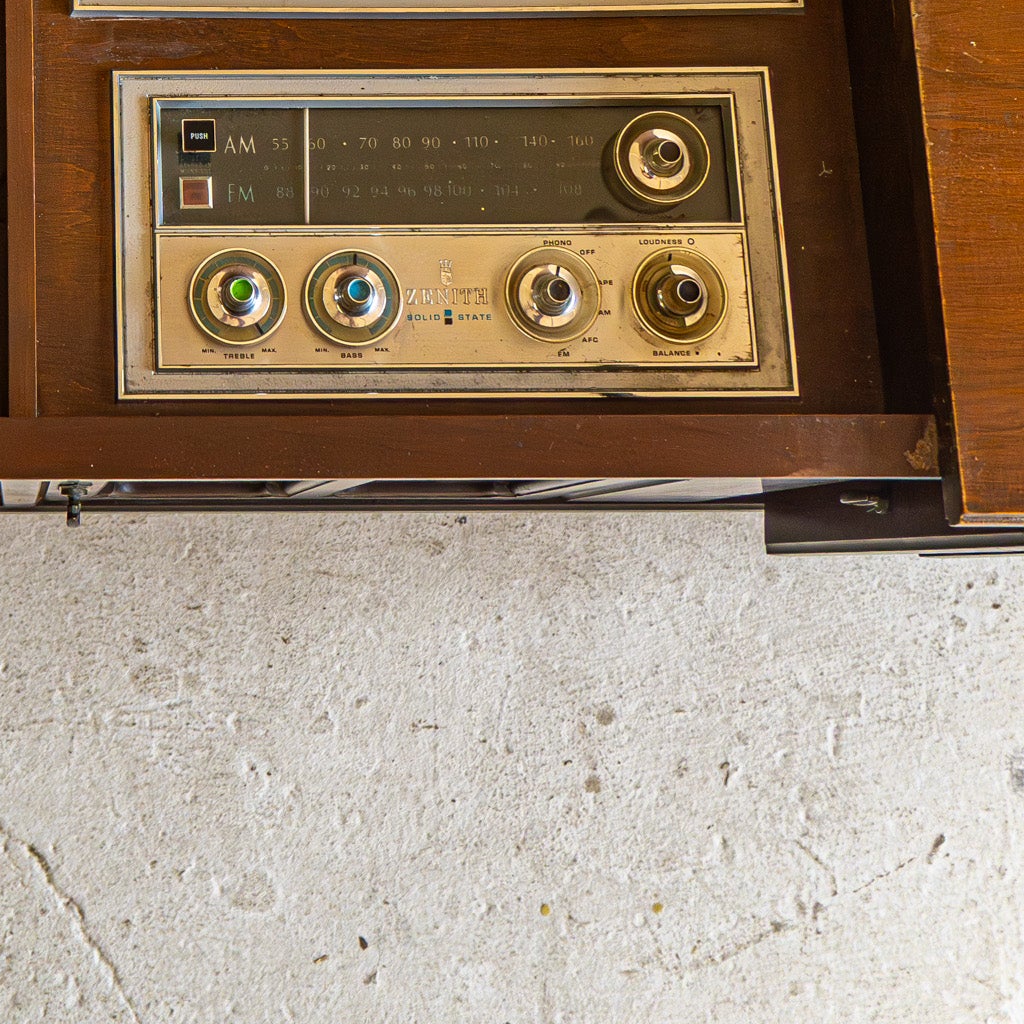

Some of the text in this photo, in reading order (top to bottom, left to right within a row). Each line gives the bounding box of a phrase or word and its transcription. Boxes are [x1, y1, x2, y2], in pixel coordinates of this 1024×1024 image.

[190, 132, 208, 140] PUSH
[224, 136, 256, 154] AM
[272, 138, 289, 151] 55
[359, 137, 377, 150] 70
[392, 136, 411, 149] 80
[421, 136, 441, 149] 90
[464, 135, 489, 148] 110
[522, 134, 548, 147] 140
[567, 134, 594, 147] 160
[228, 183, 255, 203] FM
[276, 186, 295, 199] 88
[342, 185, 360, 198] 92
[397, 184, 417, 197] 96
[423, 184, 443, 197] 98
[406, 287, 488, 305] ZENITH
